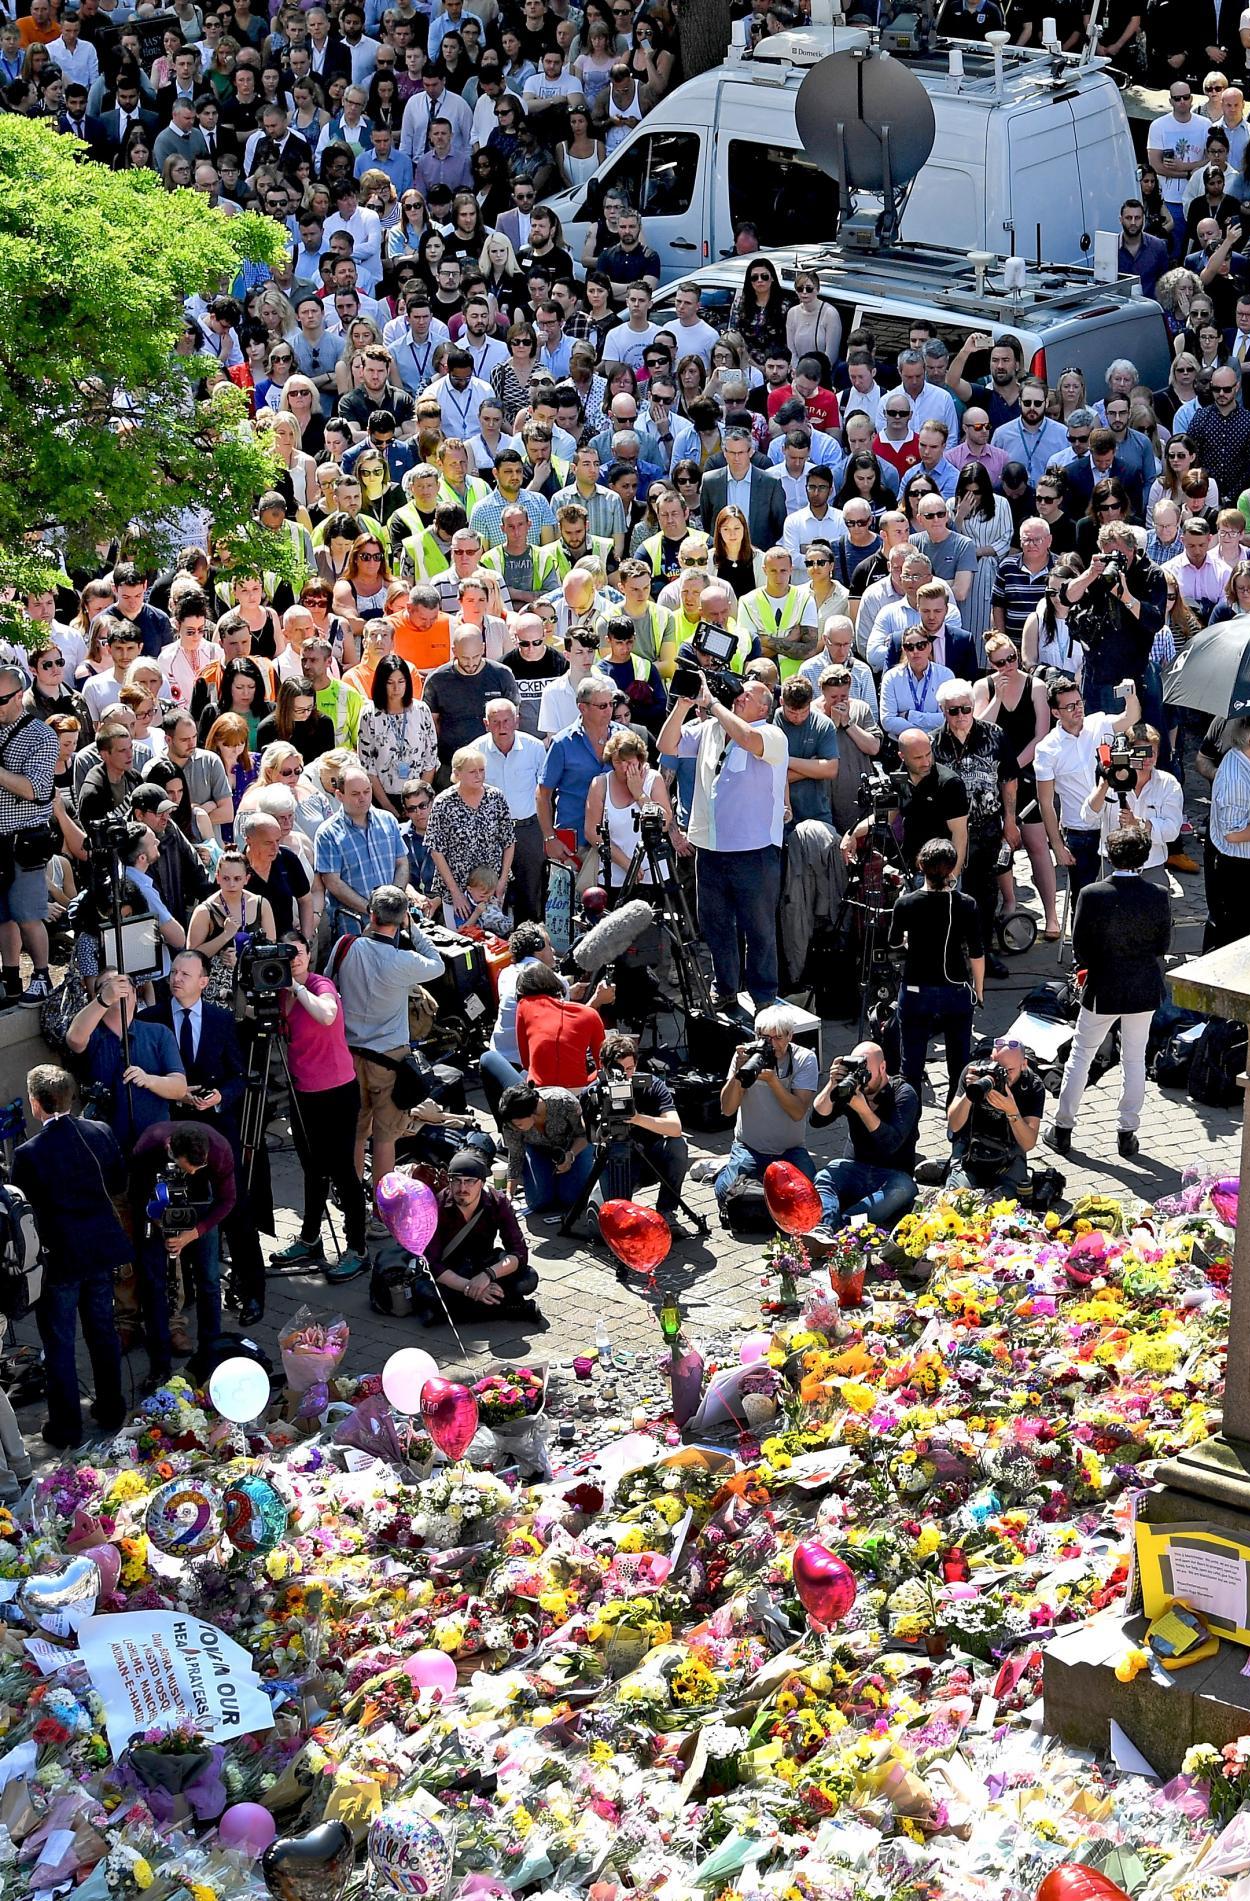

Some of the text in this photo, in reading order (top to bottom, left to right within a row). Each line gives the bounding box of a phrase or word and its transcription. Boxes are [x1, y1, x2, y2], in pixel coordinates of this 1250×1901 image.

[798, 47, 824, 58] Dometic
[804, 405, 828, 418] RAP
[163, 1489, 221, 1557] 2
[153, 1678, 172, 1714] MOSQU
[166, 1673, 187, 1717] MUSLIMS
[187, 1661, 210, 1716] PRAYERS
[216, 1682, 241, 1726] OUR
[395, 1842, 420, 1872] be
